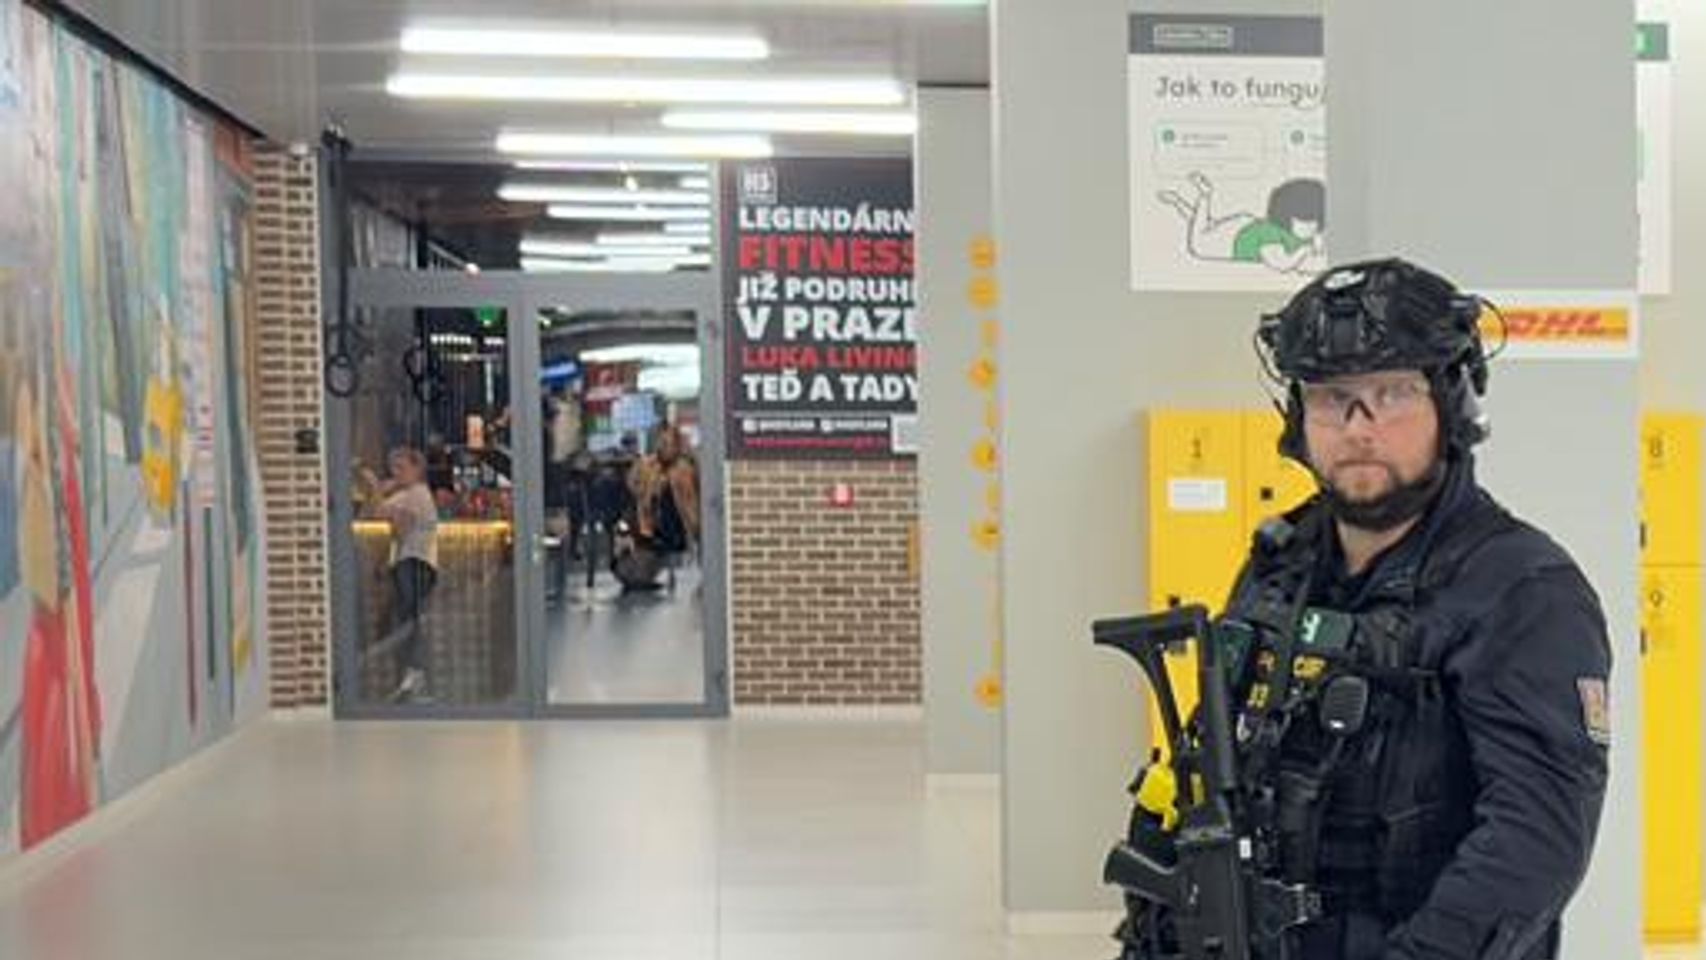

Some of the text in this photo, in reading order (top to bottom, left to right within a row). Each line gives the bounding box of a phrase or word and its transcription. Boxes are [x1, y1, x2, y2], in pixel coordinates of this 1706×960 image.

[1155, 75, 1199, 99] Jak
[1210, 79, 1237, 99] to
[737, 271, 779, 302] JIŽ
[737, 305, 772, 341] V
[1503, 311, 1602, 337] DHL
[742, 346, 818, 369] LUKA
[742, 369, 803, 401] TEĎ
[808, 374, 834, 401] A
